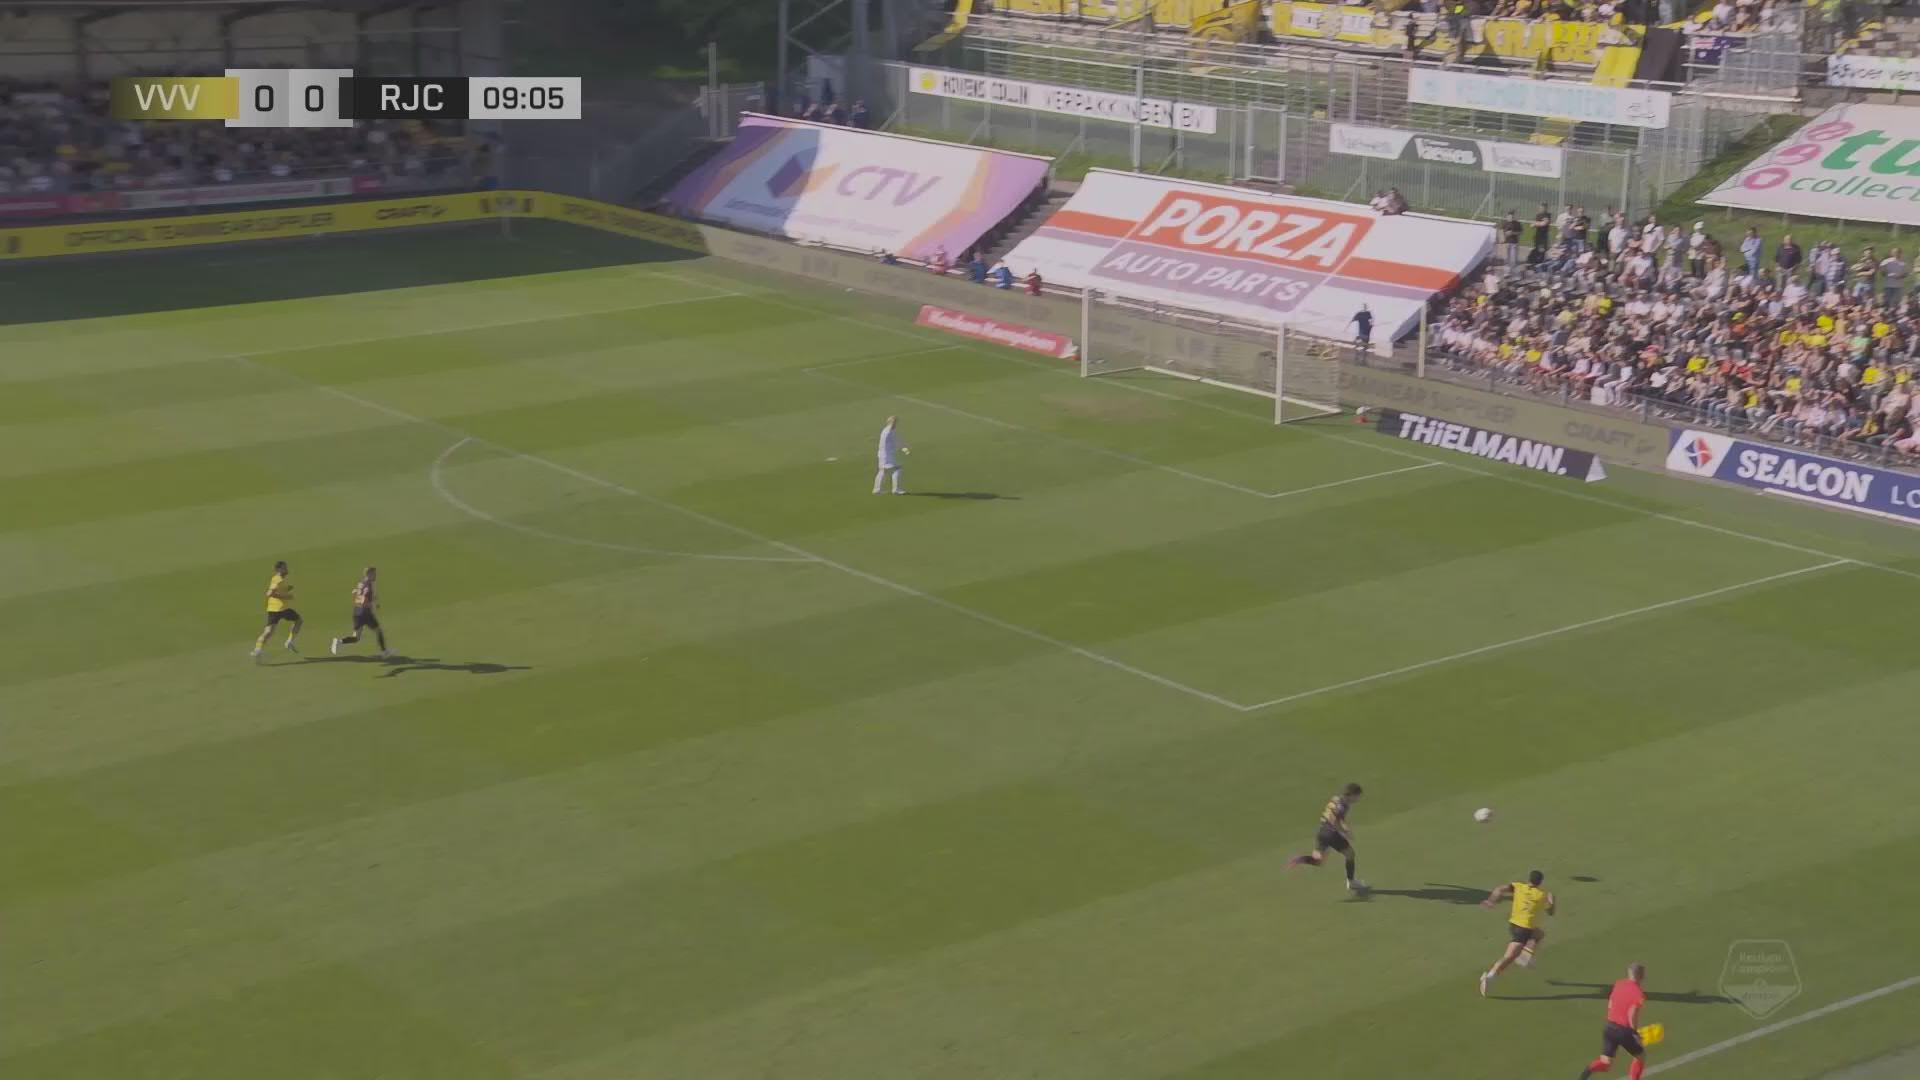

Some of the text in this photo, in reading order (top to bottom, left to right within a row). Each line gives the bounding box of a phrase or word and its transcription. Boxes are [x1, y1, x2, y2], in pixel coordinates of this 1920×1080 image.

[836, 165, 944, 206] CTV
[1130, 198, 1351, 267] PORZA
[1093, 251, 1300, 302] AUTO PARTS
[1736, 449, 1875, 504] SEACON
